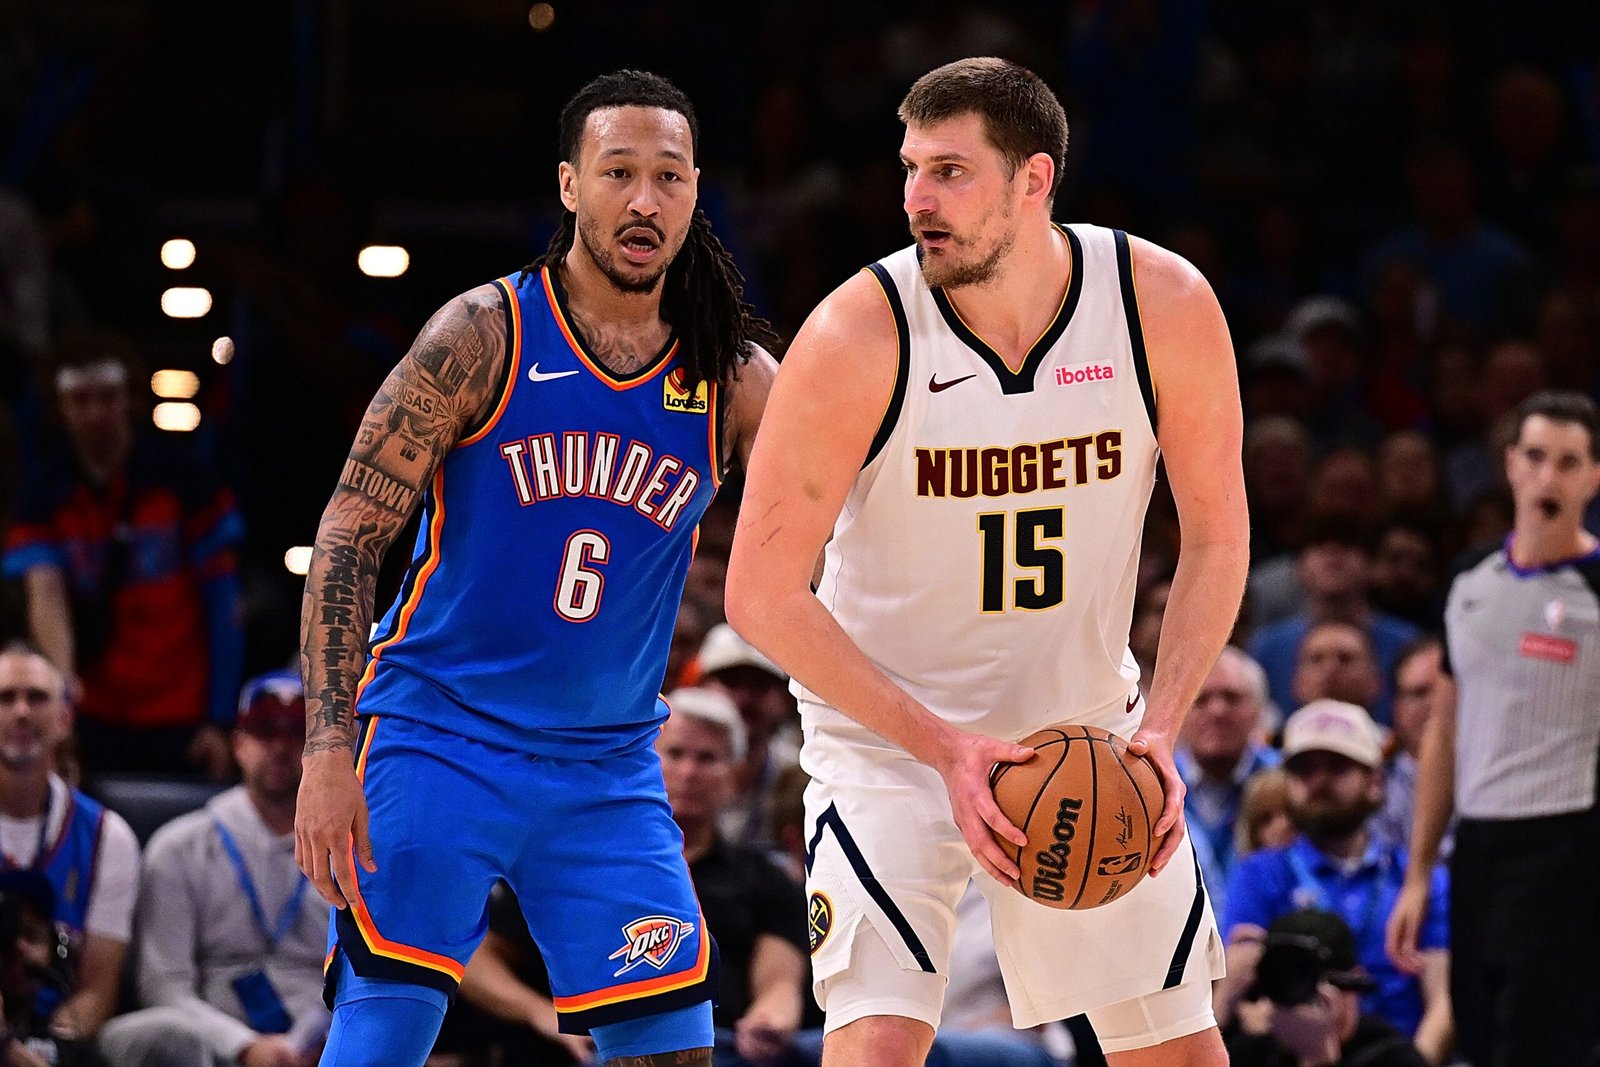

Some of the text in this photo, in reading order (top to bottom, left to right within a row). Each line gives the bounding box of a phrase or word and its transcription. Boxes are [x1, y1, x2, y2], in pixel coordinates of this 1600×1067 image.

[1056, 365, 1114, 386] ibotta
[500, 431, 699, 532] THUNDER
[914, 429, 1122, 498] NUGGETS
[553, 529, 610, 623] 6
[976, 505, 1065, 614] 15
[320, 545, 359, 727] SACRIFICE
[1033, 797, 1084, 902] Wilson
[629, 925, 670, 961] OKC
